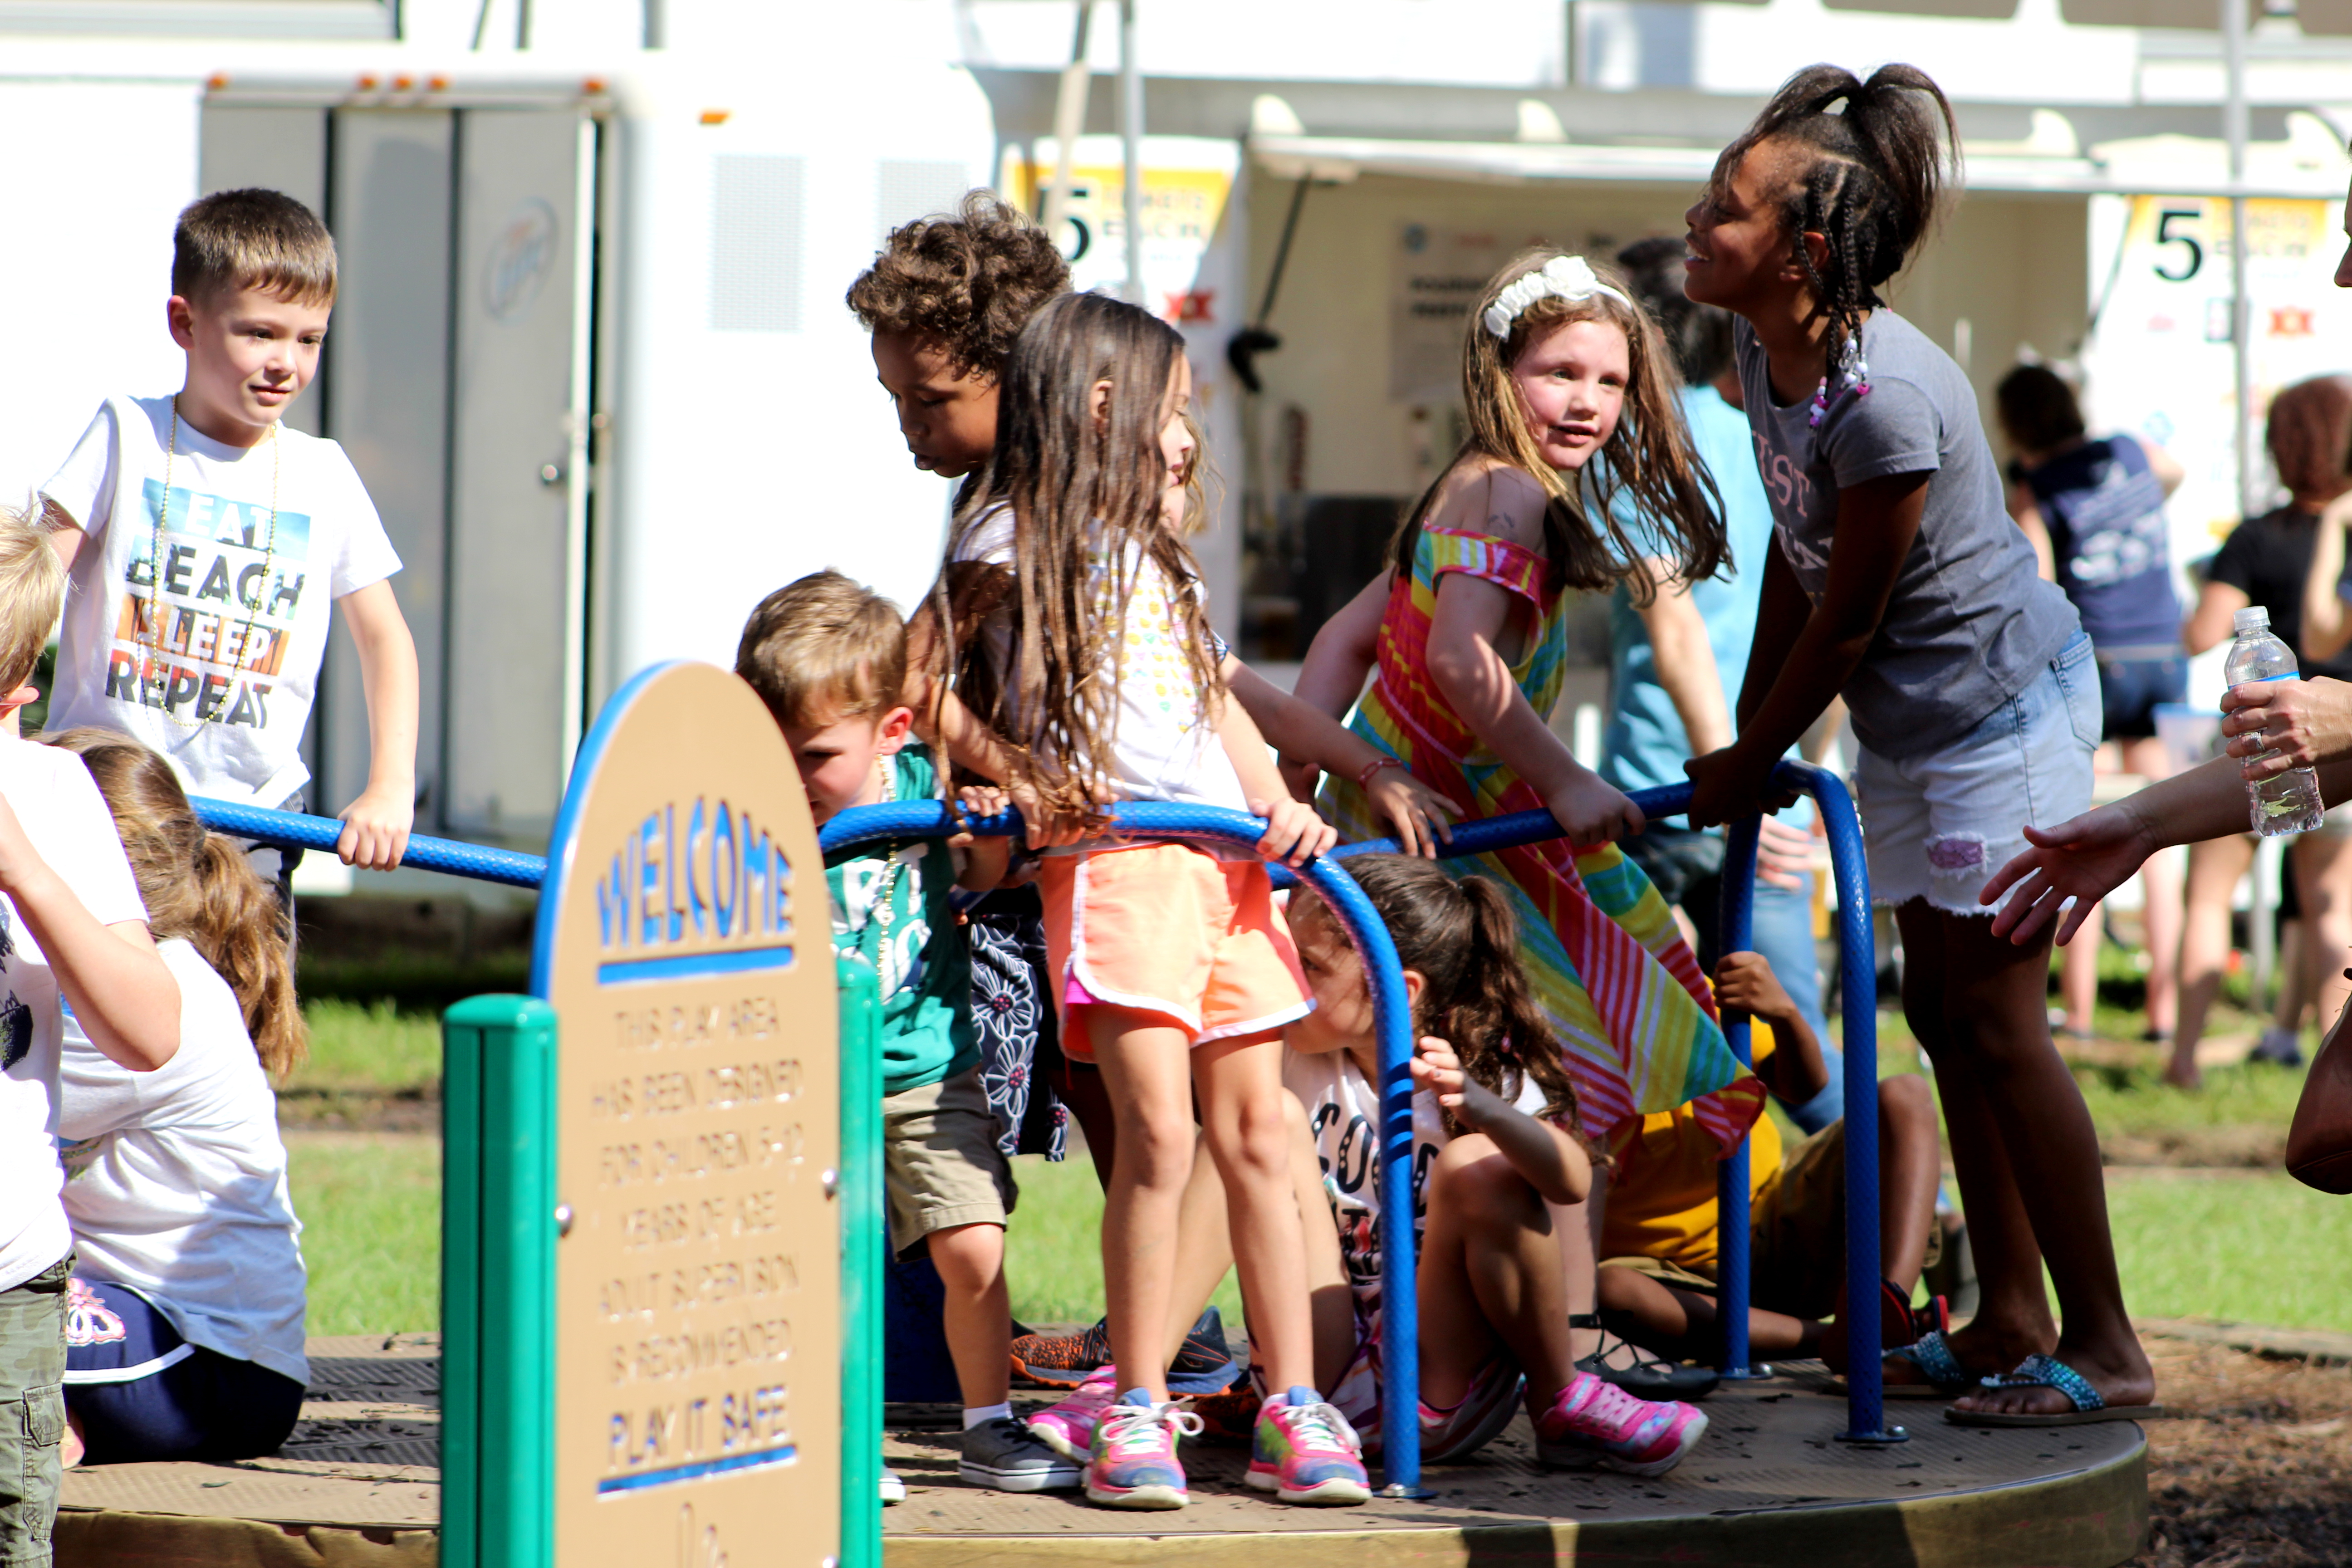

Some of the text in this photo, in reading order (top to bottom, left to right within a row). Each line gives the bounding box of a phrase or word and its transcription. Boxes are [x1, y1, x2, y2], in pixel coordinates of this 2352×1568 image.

[2152, 209, 2202, 282] 5
[184, 493, 274, 550] EAT
[126, 533, 306, 620] BEACH
[137, 602, 272, 668] SLEEP
[105, 648, 273, 729] REPEAT
[596, 794, 795, 948] WELCOME
[609, 1383, 791, 1474] PLAY IT SAFE
